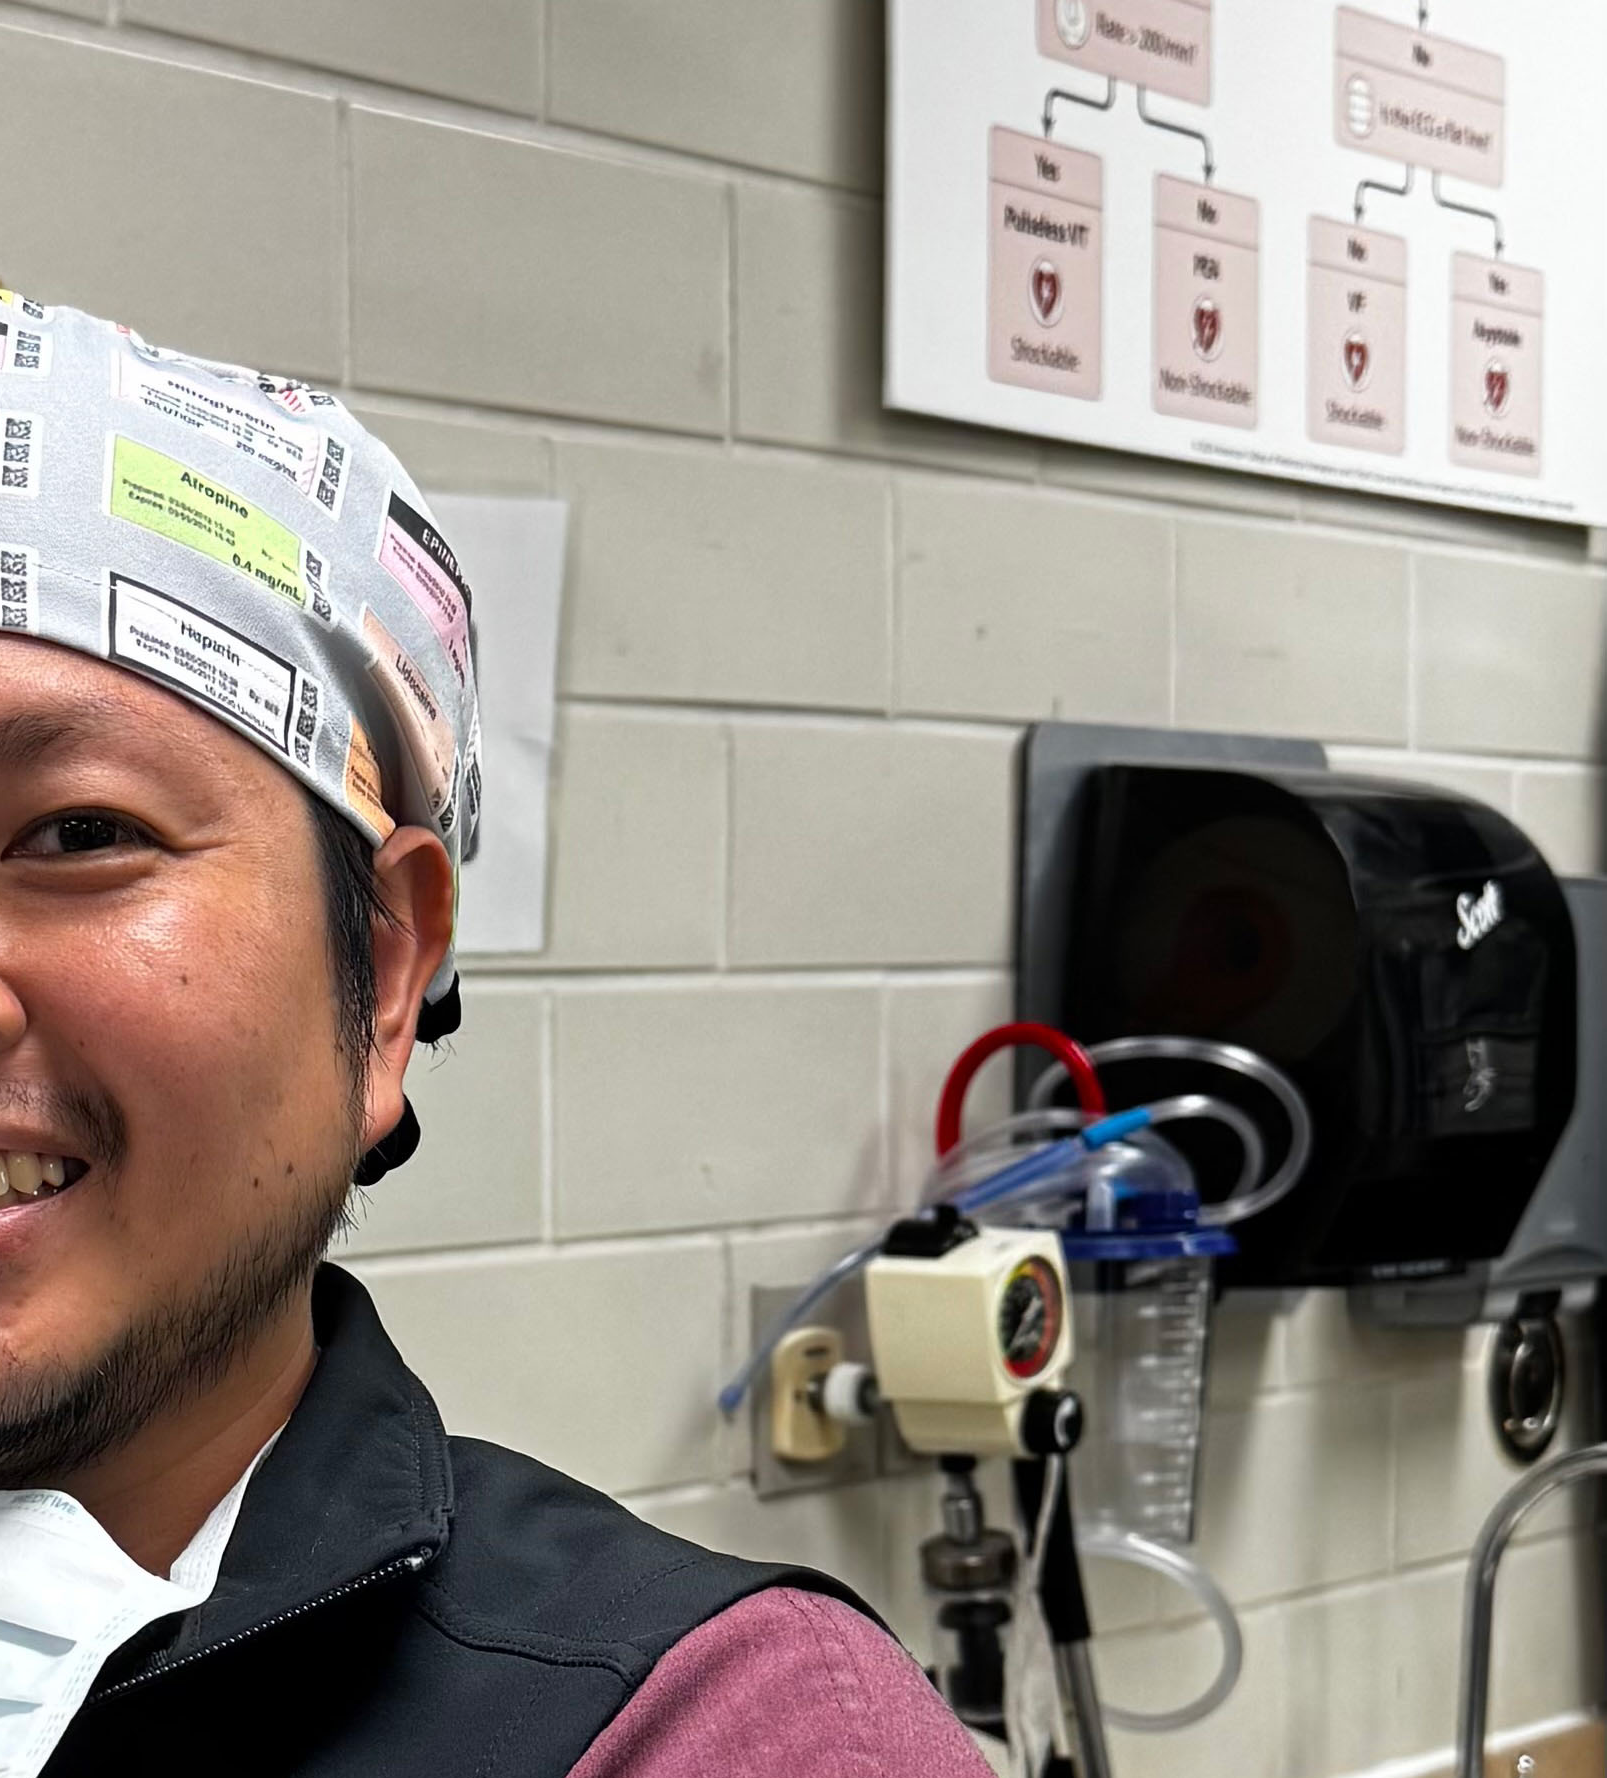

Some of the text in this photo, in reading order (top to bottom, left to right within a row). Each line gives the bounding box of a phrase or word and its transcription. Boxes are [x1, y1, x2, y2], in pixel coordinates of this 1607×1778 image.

[1035, 154, 1061, 182] Yes
[1004, 205, 1090, 248] Pulseless VT
[1197, 200, 1218, 223] No
[1011, 336, 1080, 372] Shockable
[1160, 368, 1251, 405] Non-Shockable
[1326, 400, 1384, 430] Shockable
[1455, 424, 1536, 456] Non-Shockable
[181, 471, 249, 519] Atropine
[232, 553, 301, 601] 0.4 mg/mL
[181, 620, 240, 667] Heparin
[395, 654, 437, 722] Lidocaine
